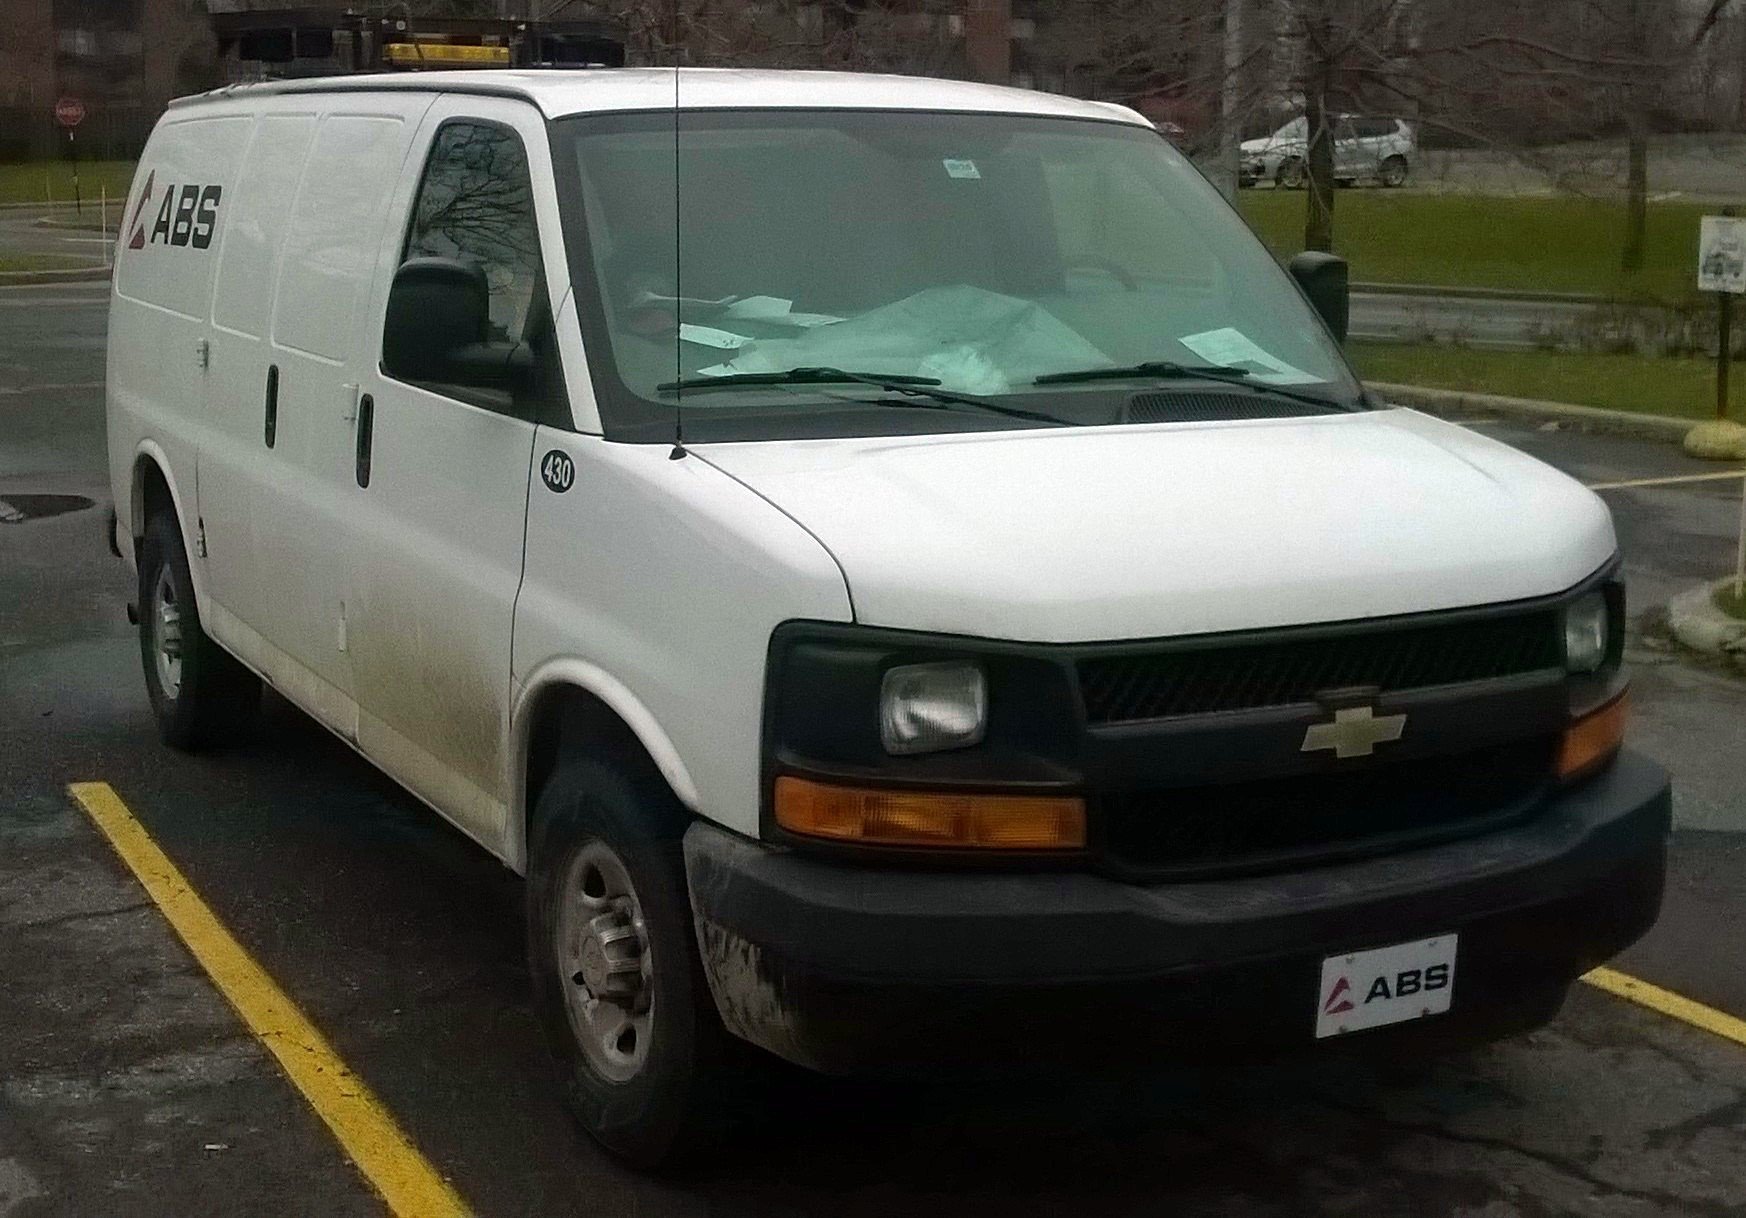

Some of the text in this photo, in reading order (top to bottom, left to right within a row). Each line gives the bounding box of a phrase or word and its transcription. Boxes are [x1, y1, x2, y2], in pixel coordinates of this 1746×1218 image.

[150, 184, 222, 249] ABS
[544, 454, 571, 488] 430
[1363, 962, 1449, 1004] ABS
